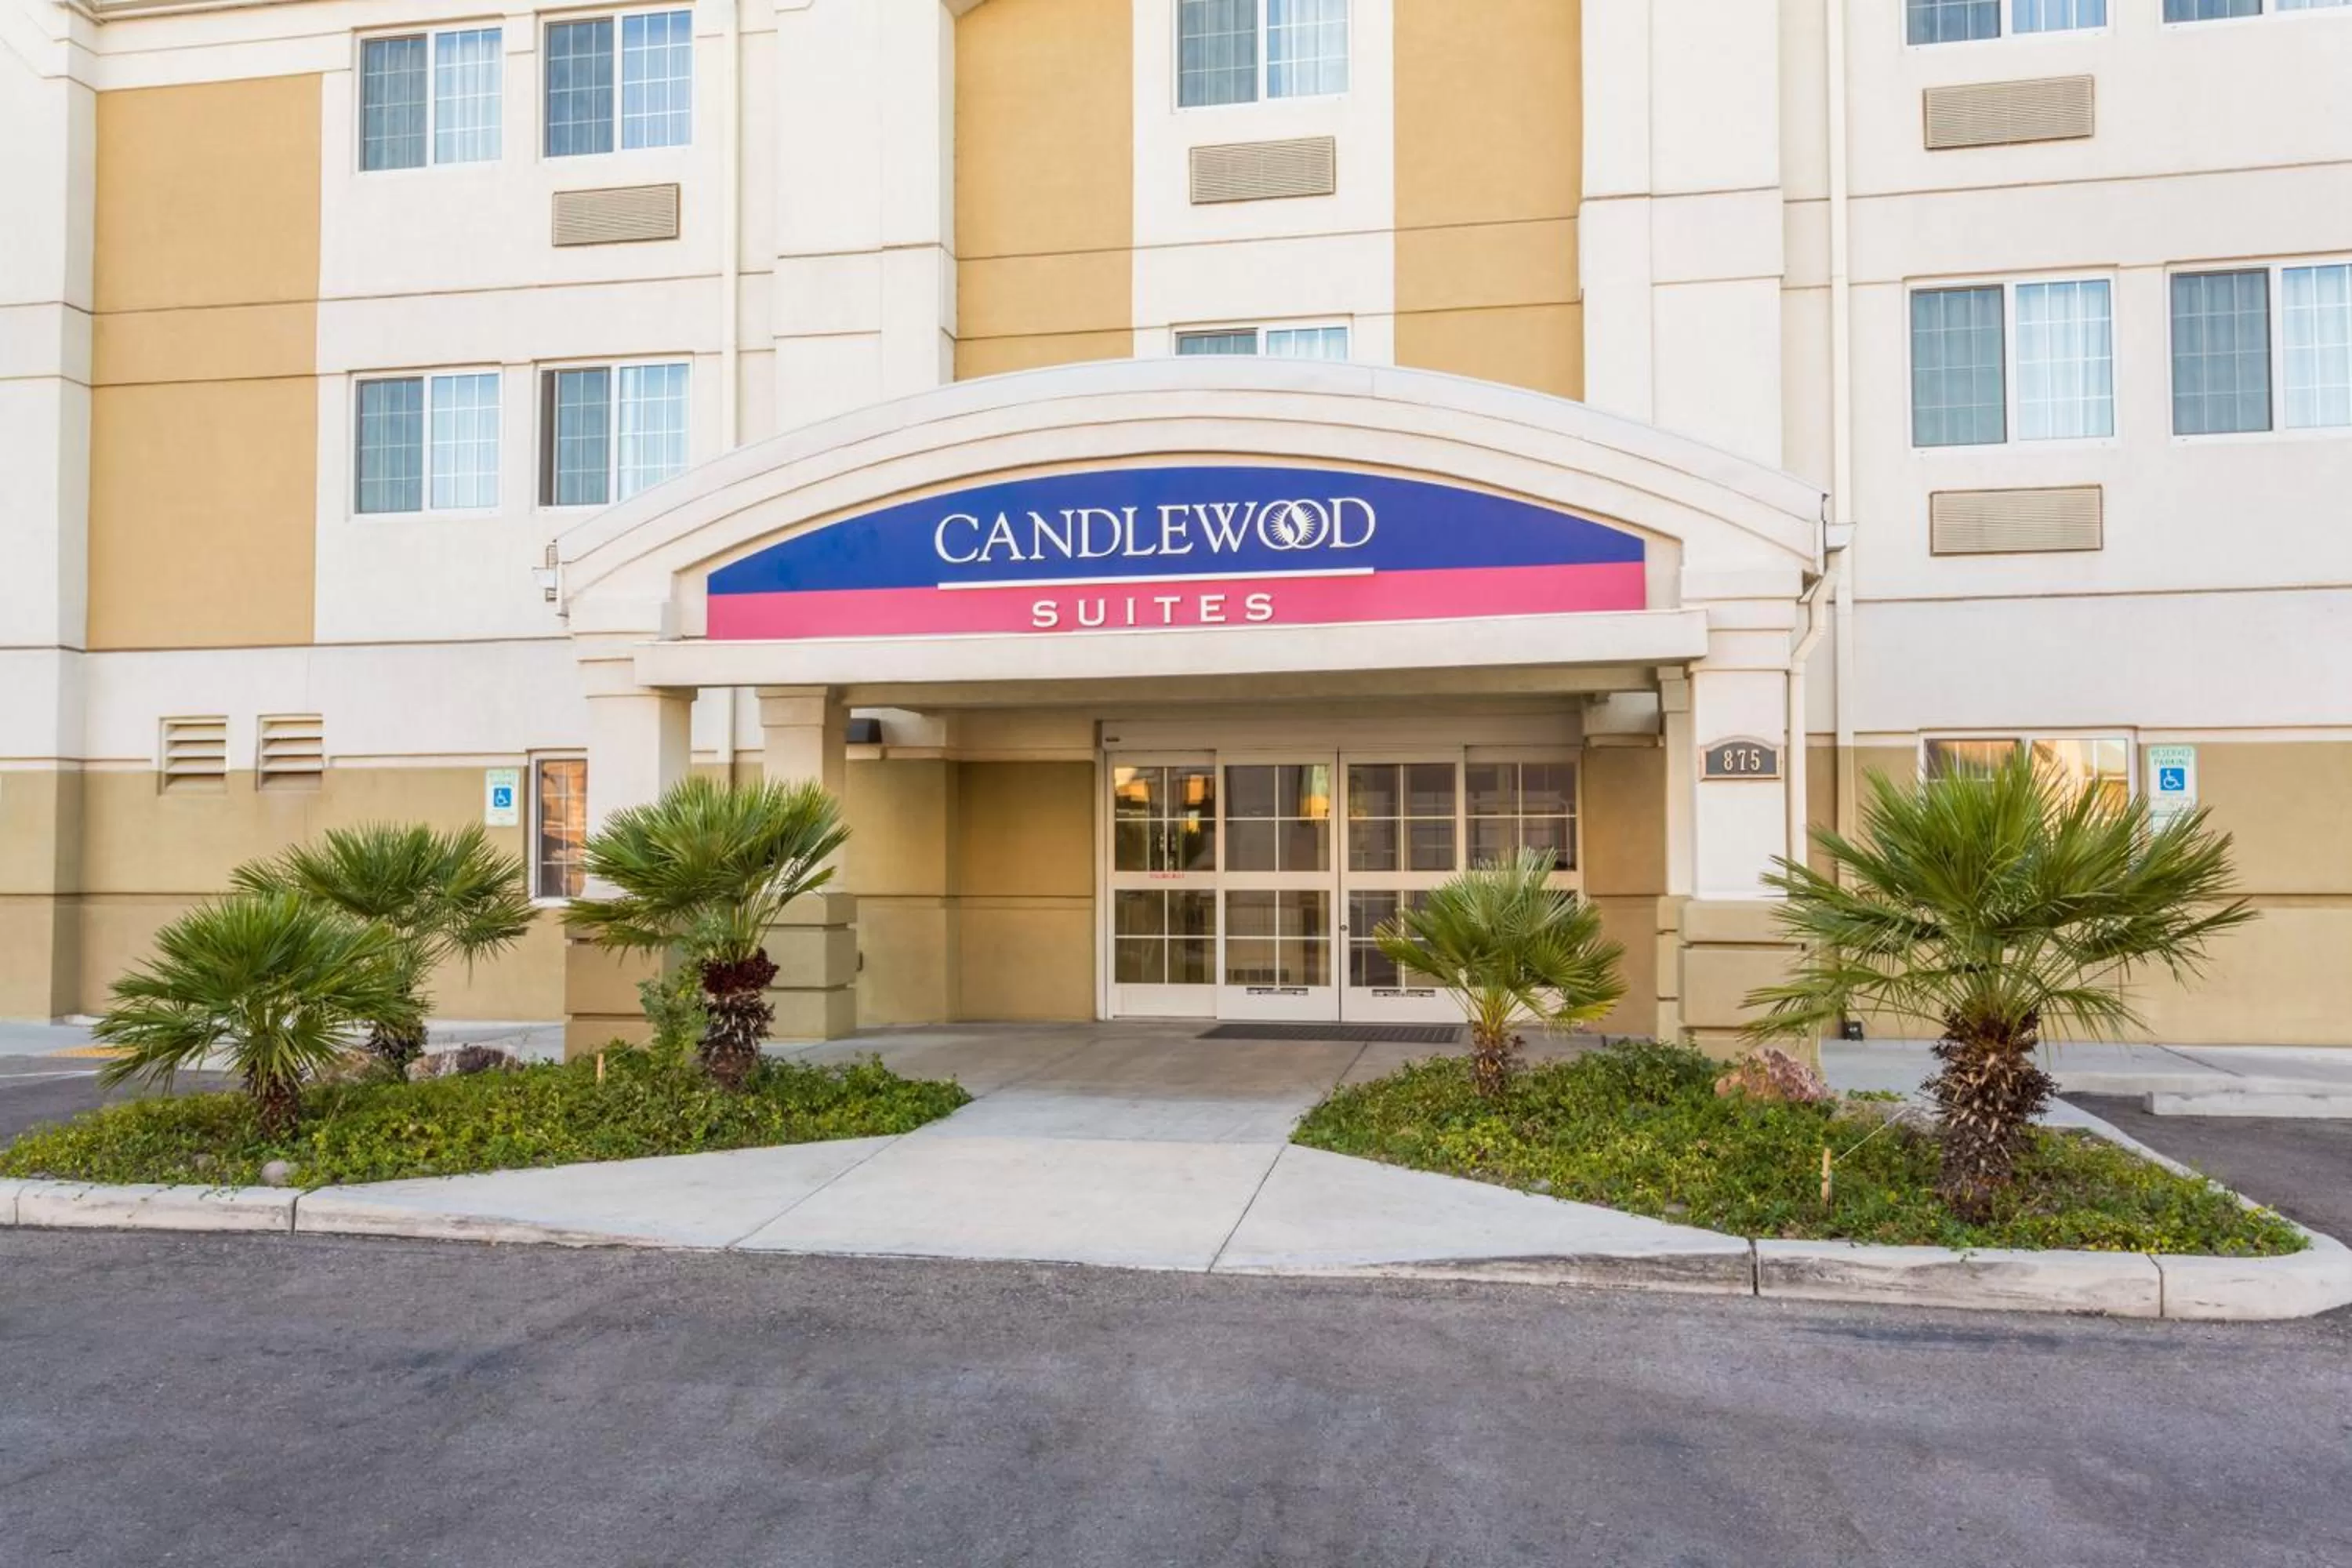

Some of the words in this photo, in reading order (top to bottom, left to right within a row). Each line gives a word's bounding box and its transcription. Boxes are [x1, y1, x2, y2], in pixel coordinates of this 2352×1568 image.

[935, 497, 1376, 563] CANDLEWOOD
[1032, 593, 1274, 627] SUITES
[1723, 749, 1761, 771] 875
